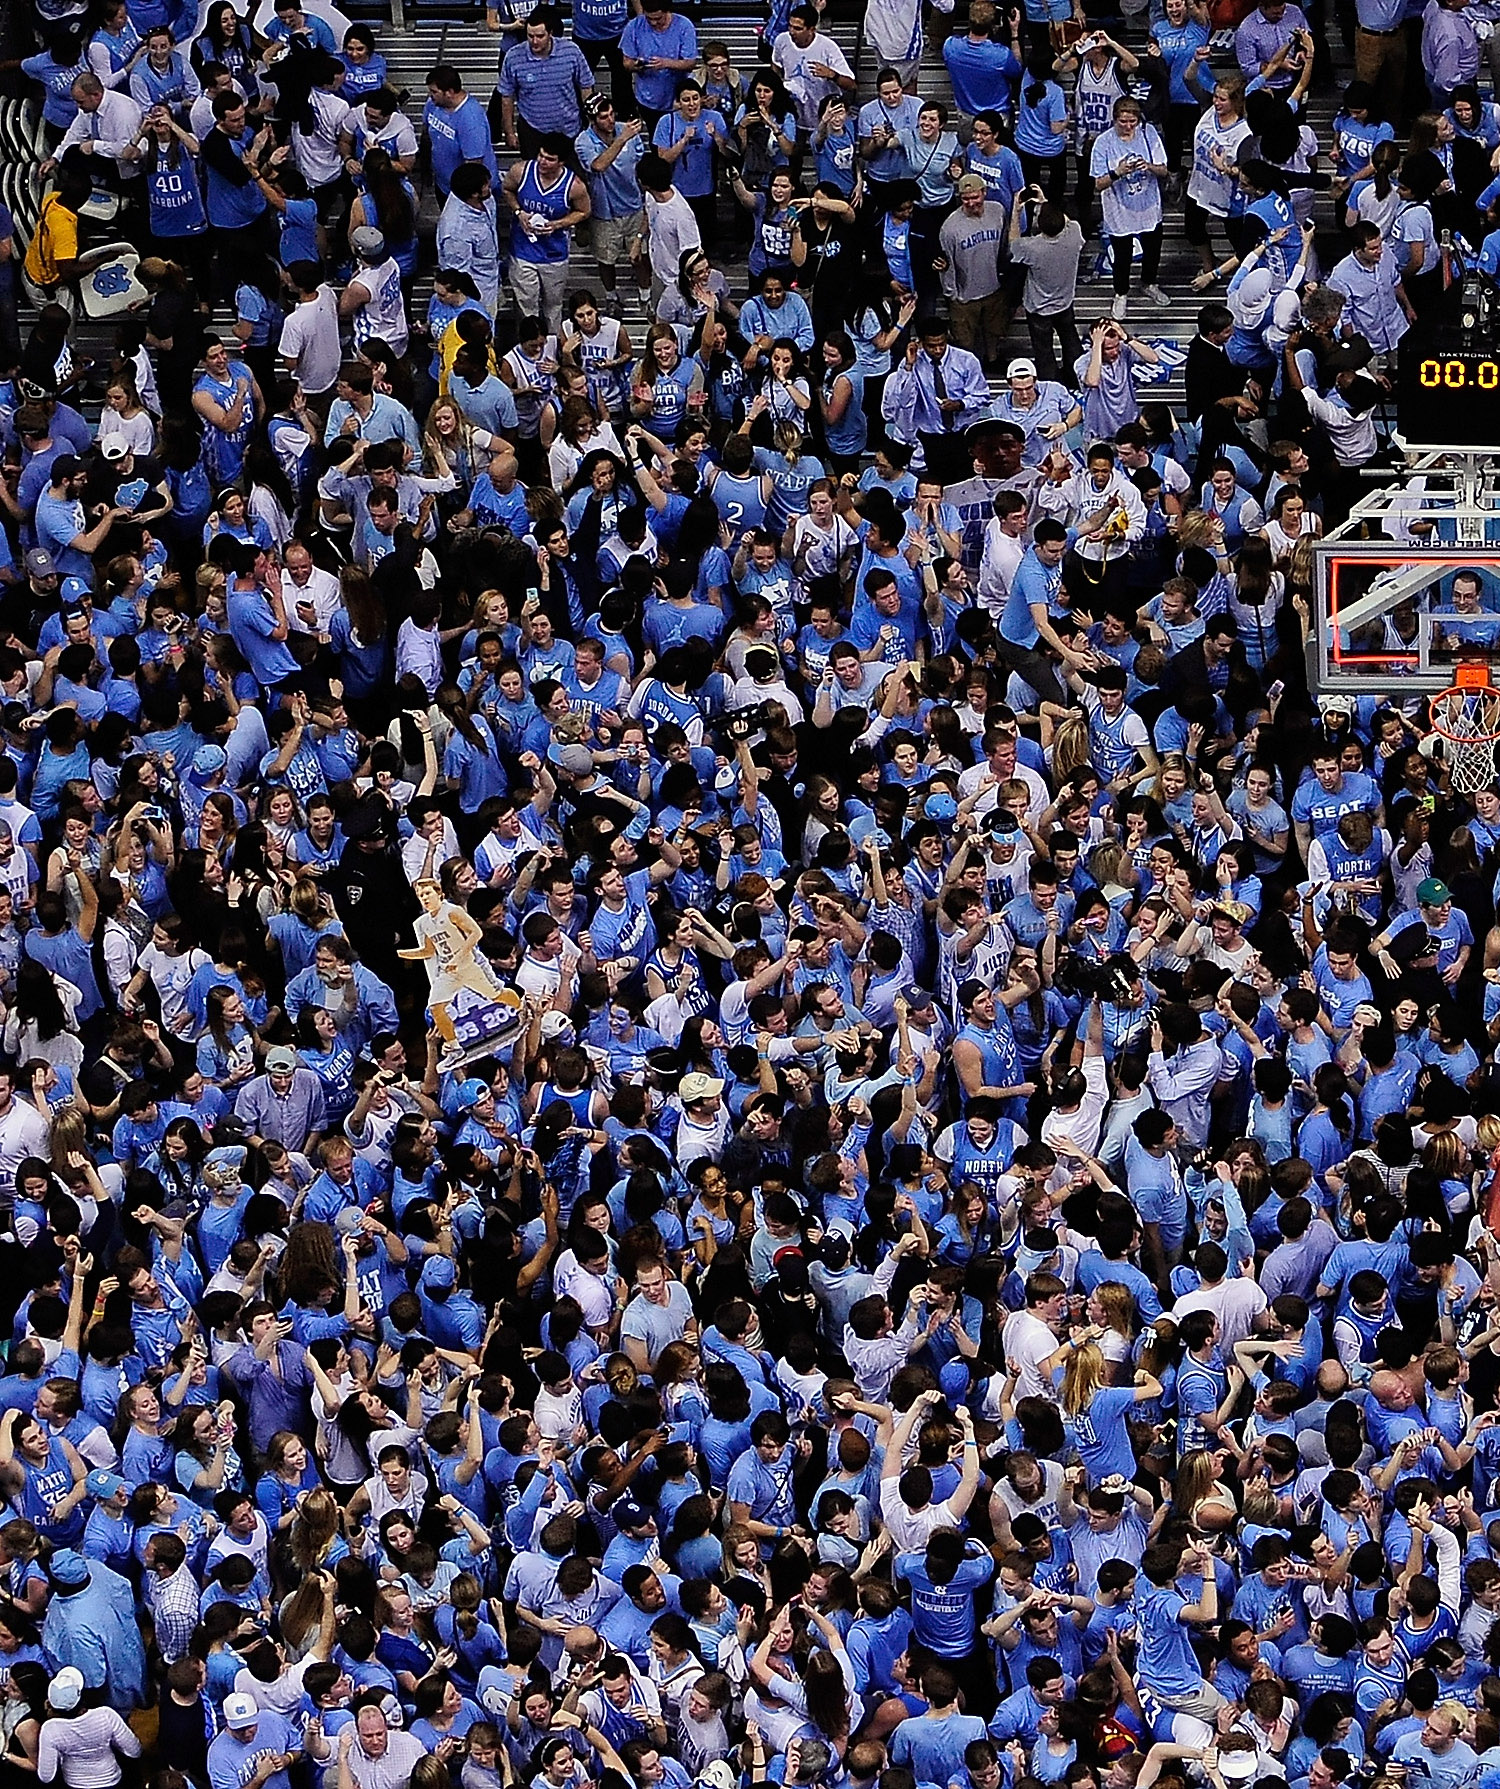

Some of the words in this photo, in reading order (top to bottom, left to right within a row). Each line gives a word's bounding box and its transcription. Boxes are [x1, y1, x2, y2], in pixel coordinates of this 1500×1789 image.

[156, 174, 183, 192] 40
[523, 198, 555, 215] NORTH
[582, 345, 608, 358] ORTH
[1421, 361, 1499, 389] 00.0
[726, 501, 745, 525] 2
[569, 698, 603, 715] NORTH
[648, 698, 681, 725] JORDAN
[1312, 803, 1362, 819] BEAT
[1336, 860, 1371, 876] NORTH
[1003, 1043, 1016, 1068] 35
[326, 1052, 353, 1083] NORTH
[964, 1160, 1004, 1174] NORTH
[37, 1470, 68, 1491] NORTH
